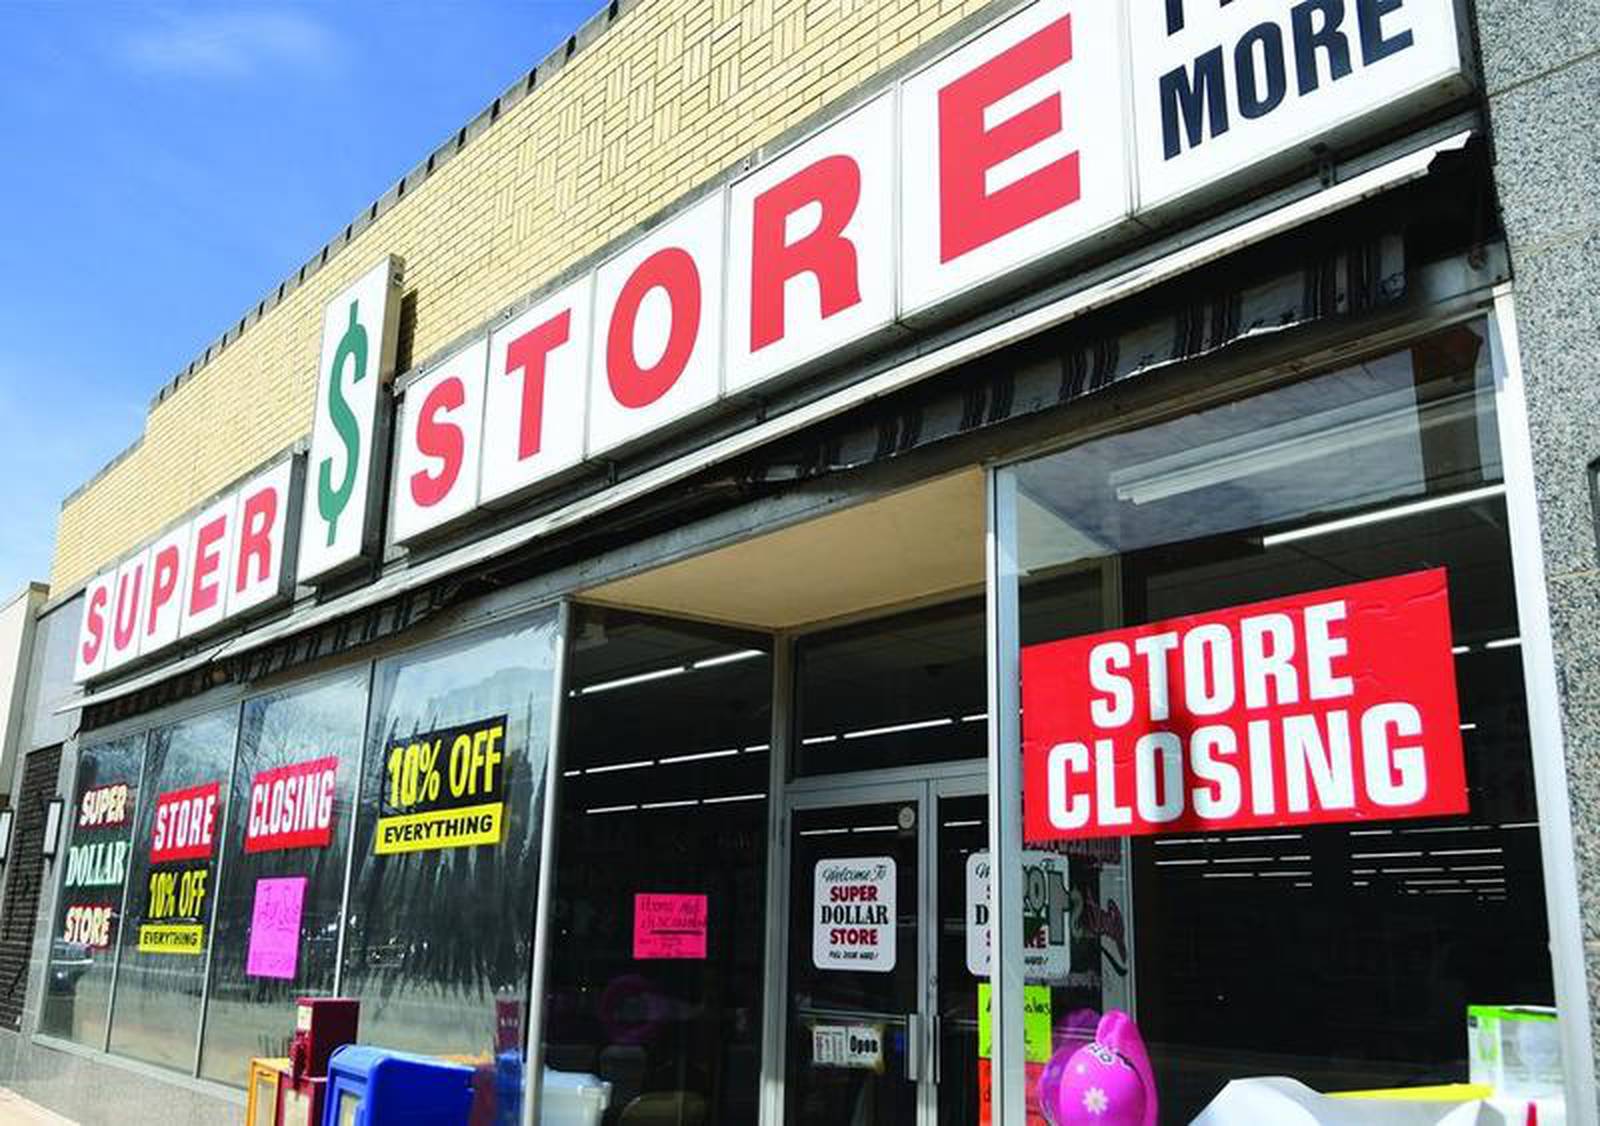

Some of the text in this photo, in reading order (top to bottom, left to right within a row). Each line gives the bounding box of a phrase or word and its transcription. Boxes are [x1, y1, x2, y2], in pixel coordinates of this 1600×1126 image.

[1159, 0, 1415, 161] MORE
[82, 13, 1082, 664] SUPER $ STORE
[1089, 599, 1355, 729] STORE
[388, 725, 503, 808] 10% OFF
[1047, 701, 1429, 830] CLOSING
[79, 784, 129, 827] SUPER
[153, 795, 216, 852] STORE
[249, 769, 336, 838] CLOSING
[384, 813, 493, 844] EVERYTHING
[65, 841, 127, 887] DOLLAR
[822, 865, 871, 883] Welcome
[148, 871, 178, 919] 10%
[178, 869, 208, 918] OFF
[820, 904, 889, 925] DOLLAR
[830, 885, 878, 902] SUPER
[63, 906, 113, 947] STORE
[143, 931, 198, 946] EVERYTHING
[830, 928, 878, 946] STORE
